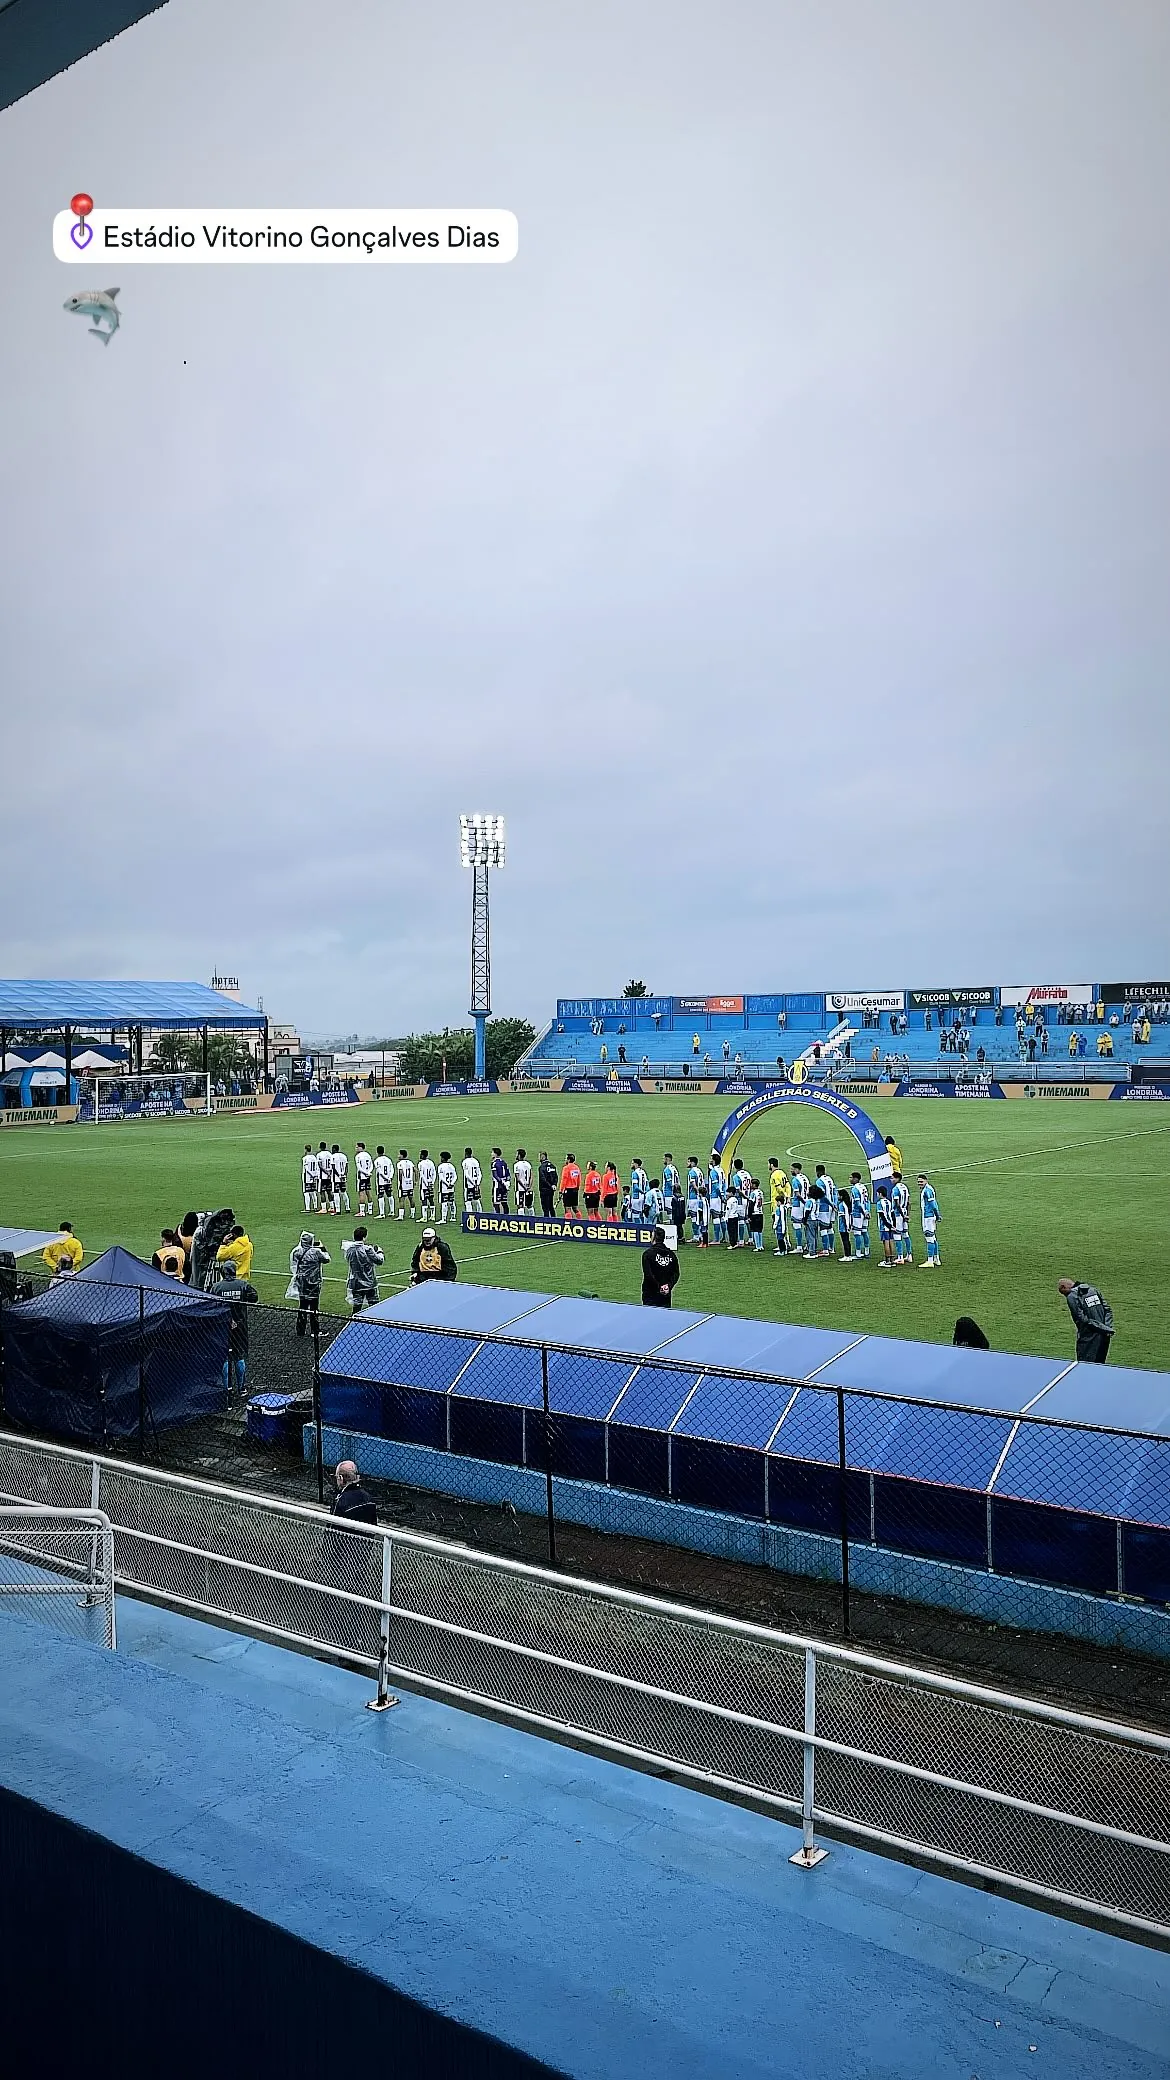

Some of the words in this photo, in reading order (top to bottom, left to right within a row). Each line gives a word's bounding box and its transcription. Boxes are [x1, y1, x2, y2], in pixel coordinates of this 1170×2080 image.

[921, 993, 950, 1002] SICOOB
[961, 991, 991, 1001] SICOOB
[847, 997, 900, 1007] UniCesumar
[665, 1082, 702, 1092] TIMEMANIA
[834, 1084, 878, 1094] TIMEMANIA
[1038, 1086, 1090, 1097] TIMEMANIA
[216, 1097, 257, 1108] TIMEMANIA
[735, 1086, 811, 1120] BRASILEIRÃO
[811, 1090, 849, 1112] SÉRIE
[847, 1108, 858, 1120] B
[6, 1109, 58, 1122] TIMEMANIA
[479, 1219, 584, 1238] BRASILEIRÃO
[586, 1224, 637, 1242] SÉRIE
[640, 1230, 652, 1243] B
